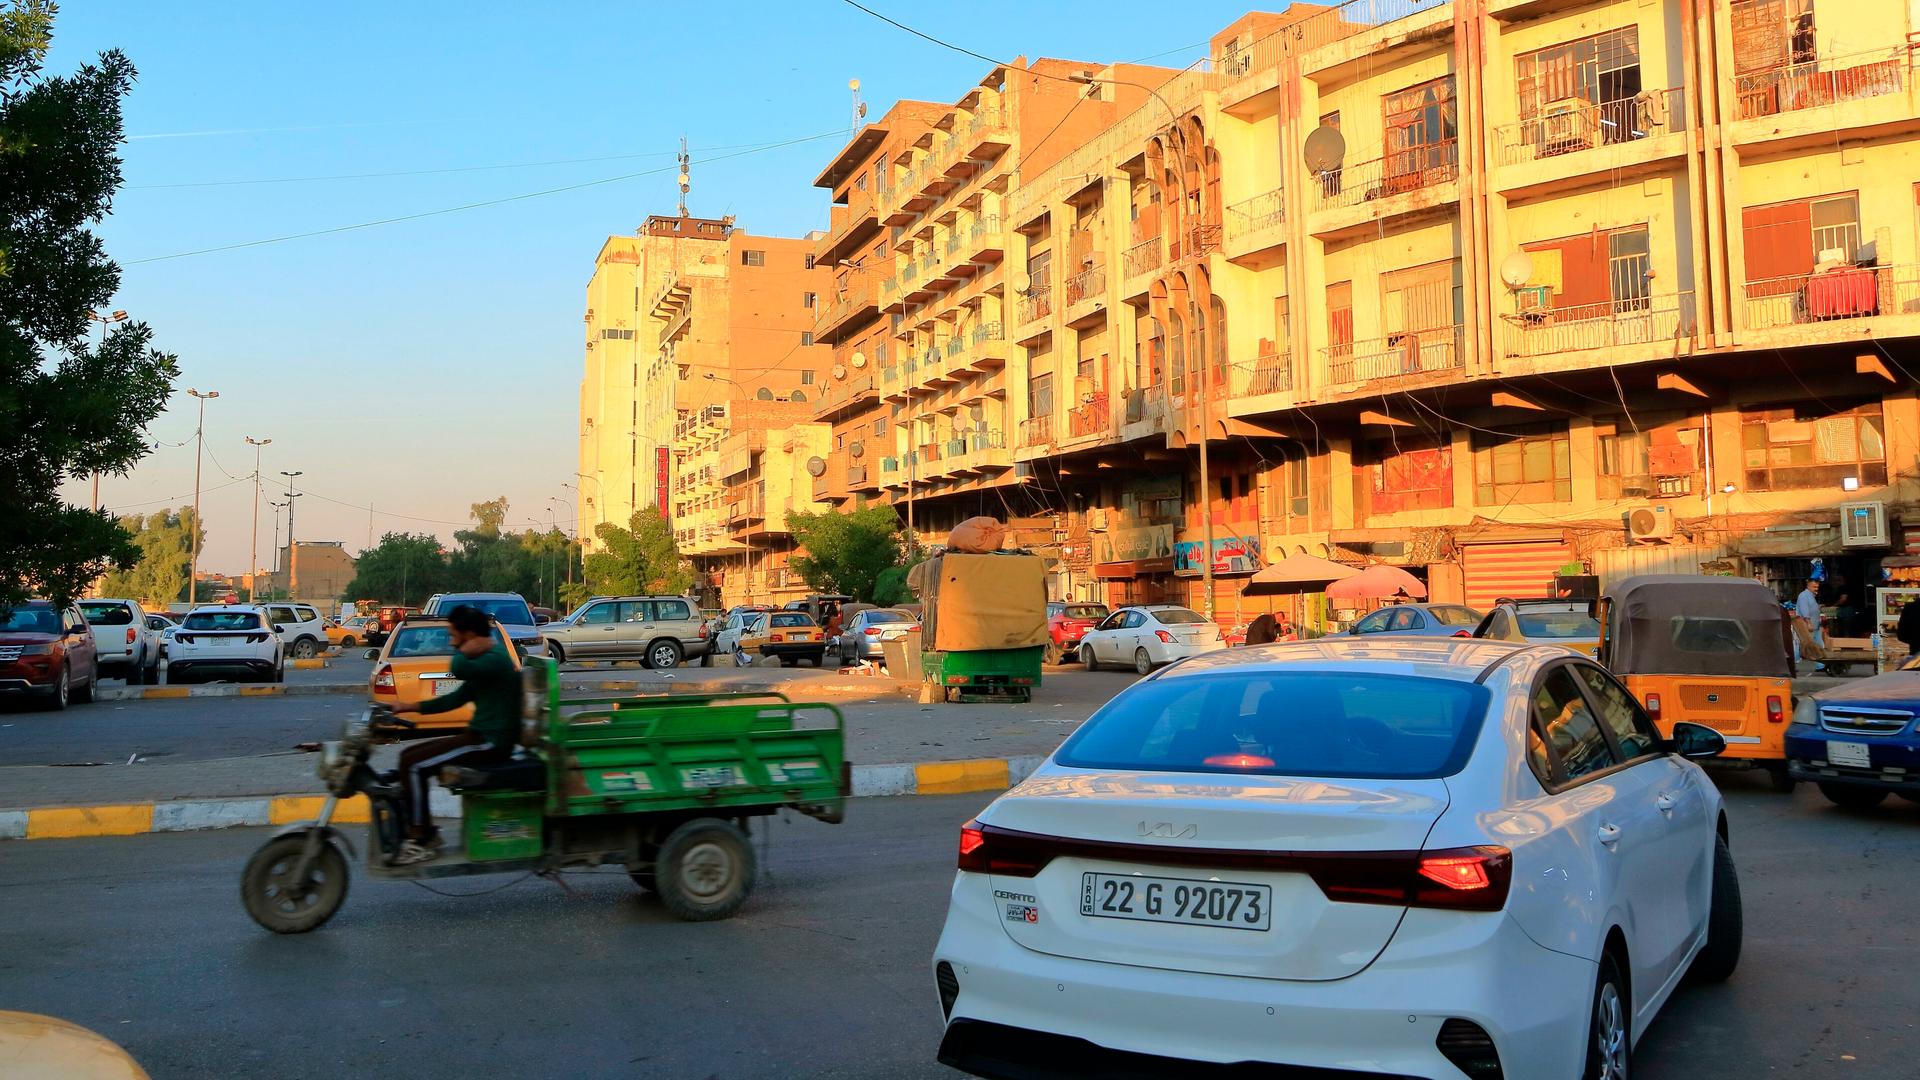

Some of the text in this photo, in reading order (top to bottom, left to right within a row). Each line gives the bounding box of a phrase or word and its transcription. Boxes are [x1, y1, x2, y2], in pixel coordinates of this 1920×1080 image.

[994, 890, 1036, 903] CERATO
[1102, 880, 1261, 924] 22 G 92073
[1082, 905, 1093, 914] KR
